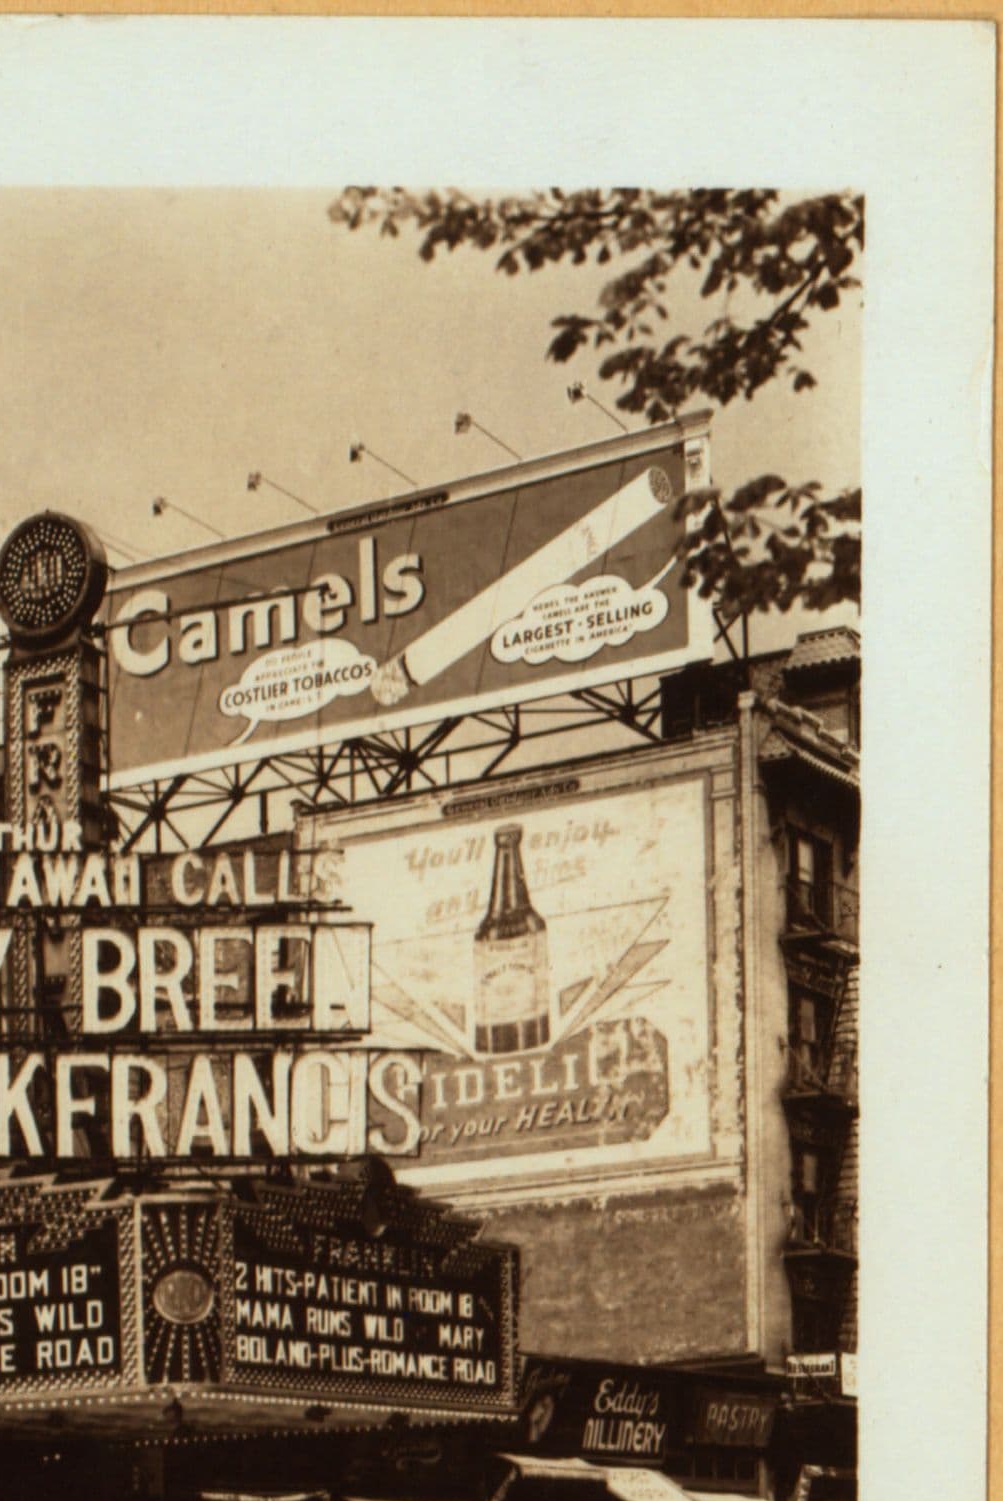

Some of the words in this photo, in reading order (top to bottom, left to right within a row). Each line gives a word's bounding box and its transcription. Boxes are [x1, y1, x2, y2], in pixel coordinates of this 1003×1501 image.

[111, 536, 424, 676] Camels
[502, 620, 574, 649] LARGEST
[586, 601, 654, 629] SELLING
[225, 681, 289, 709] COSTLIER
[292, 661, 373, 692] TOBACCOS
[171, 846, 347, 907] CALLS
[82, 925, 372, 1034] BREEN
[418, 1124, 445, 1144] or
[451, 1117, 508, 1146] your
[312, 1234, 434, 1279] FRANKLIN
[235, 1261, 248, 1291] 2
[385, 1283, 402, 1311] IN
[408, 1287, 452, 1315] ROOM
[34, 1299, 104, 1334] WILD
[235, 1299, 294, 1330] MAMA
[305, 1306, 352, 1338] RUNS
[363, 1313, 405, 1343] WILD
[438, 1324, 485, 1352] MARY
[36, 1335, 115, 1371] ROAD
[453, 1355, 497, 1386] ROAD
[594, 1378, 660, 1421] Eddy's
[705, 1401, 771, 1433] PASTRY
